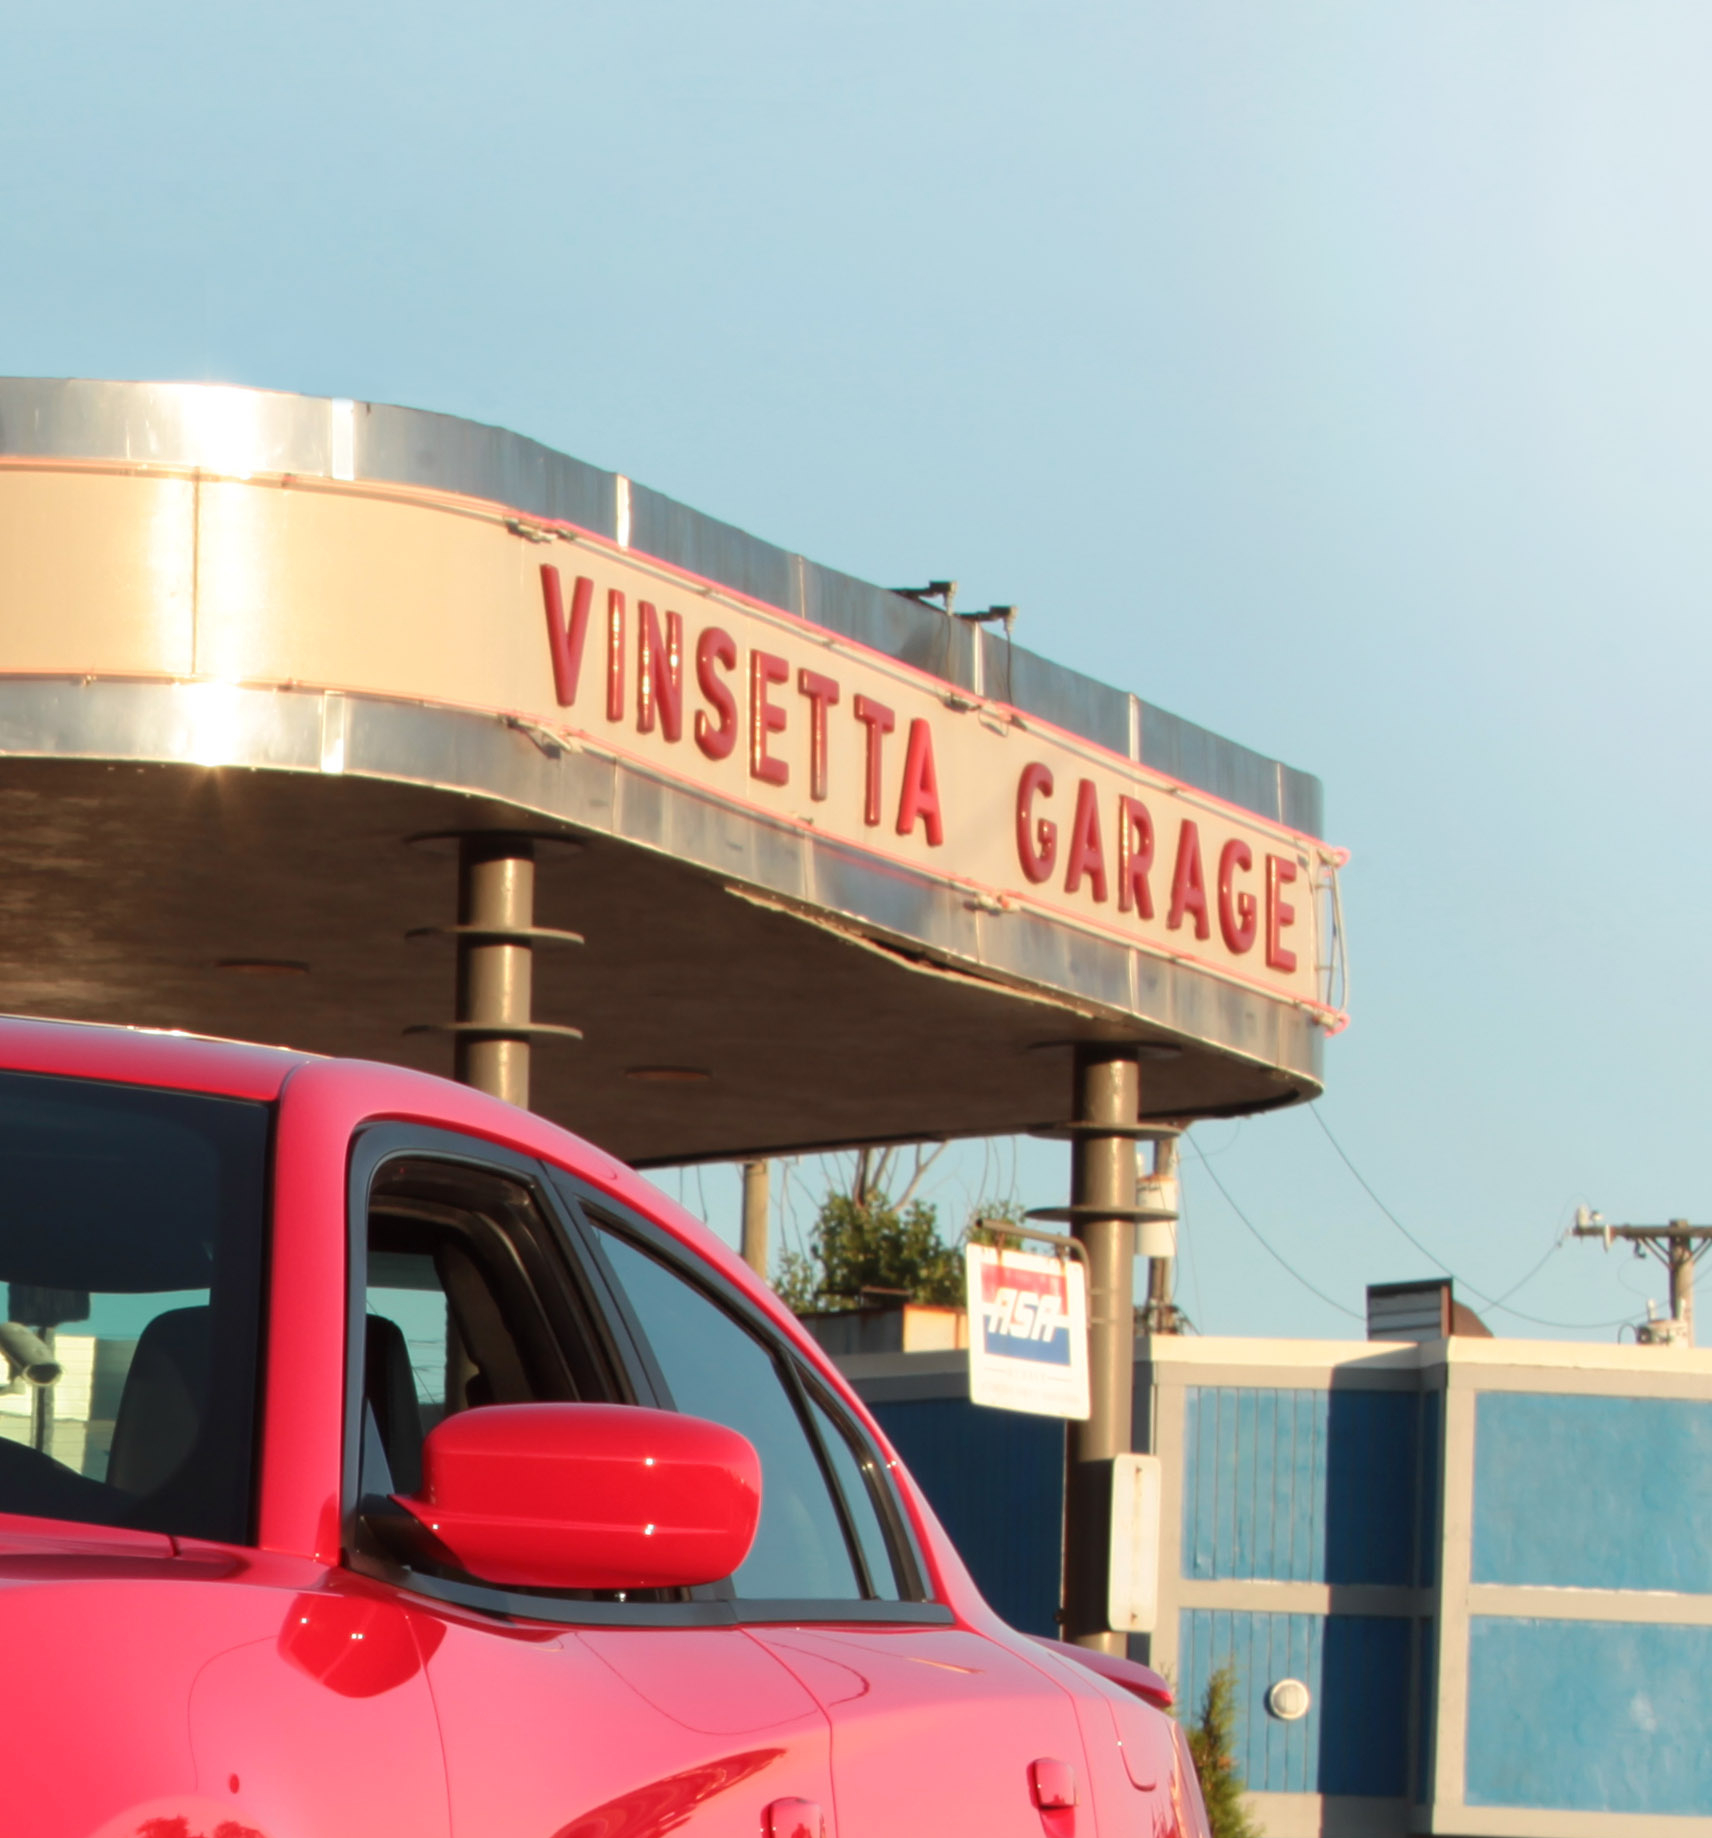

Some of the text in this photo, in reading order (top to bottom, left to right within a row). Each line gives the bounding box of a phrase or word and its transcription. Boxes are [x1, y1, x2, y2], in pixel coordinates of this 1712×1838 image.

[540, 562, 1298, 974] VINSETTA GARAGE
[987, 1287, 1062, 1343] ASA
